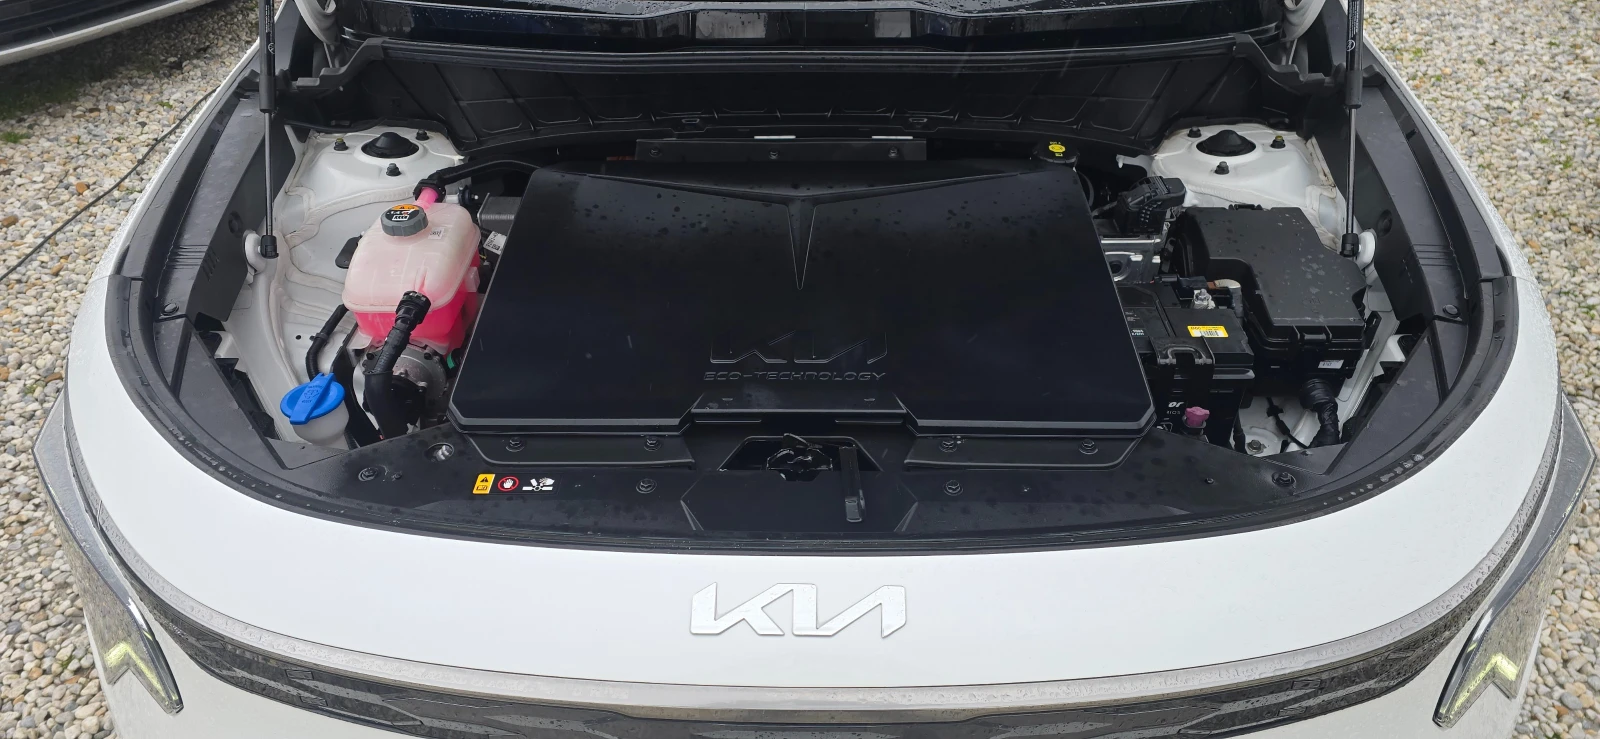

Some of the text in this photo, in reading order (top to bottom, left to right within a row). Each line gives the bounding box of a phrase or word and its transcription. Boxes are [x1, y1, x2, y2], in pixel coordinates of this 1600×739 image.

[709, 330, 888, 365] KIA
[703, 371, 887, 381] ECO-TECHNOLOGY
[690, 581, 907, 639] KIA
